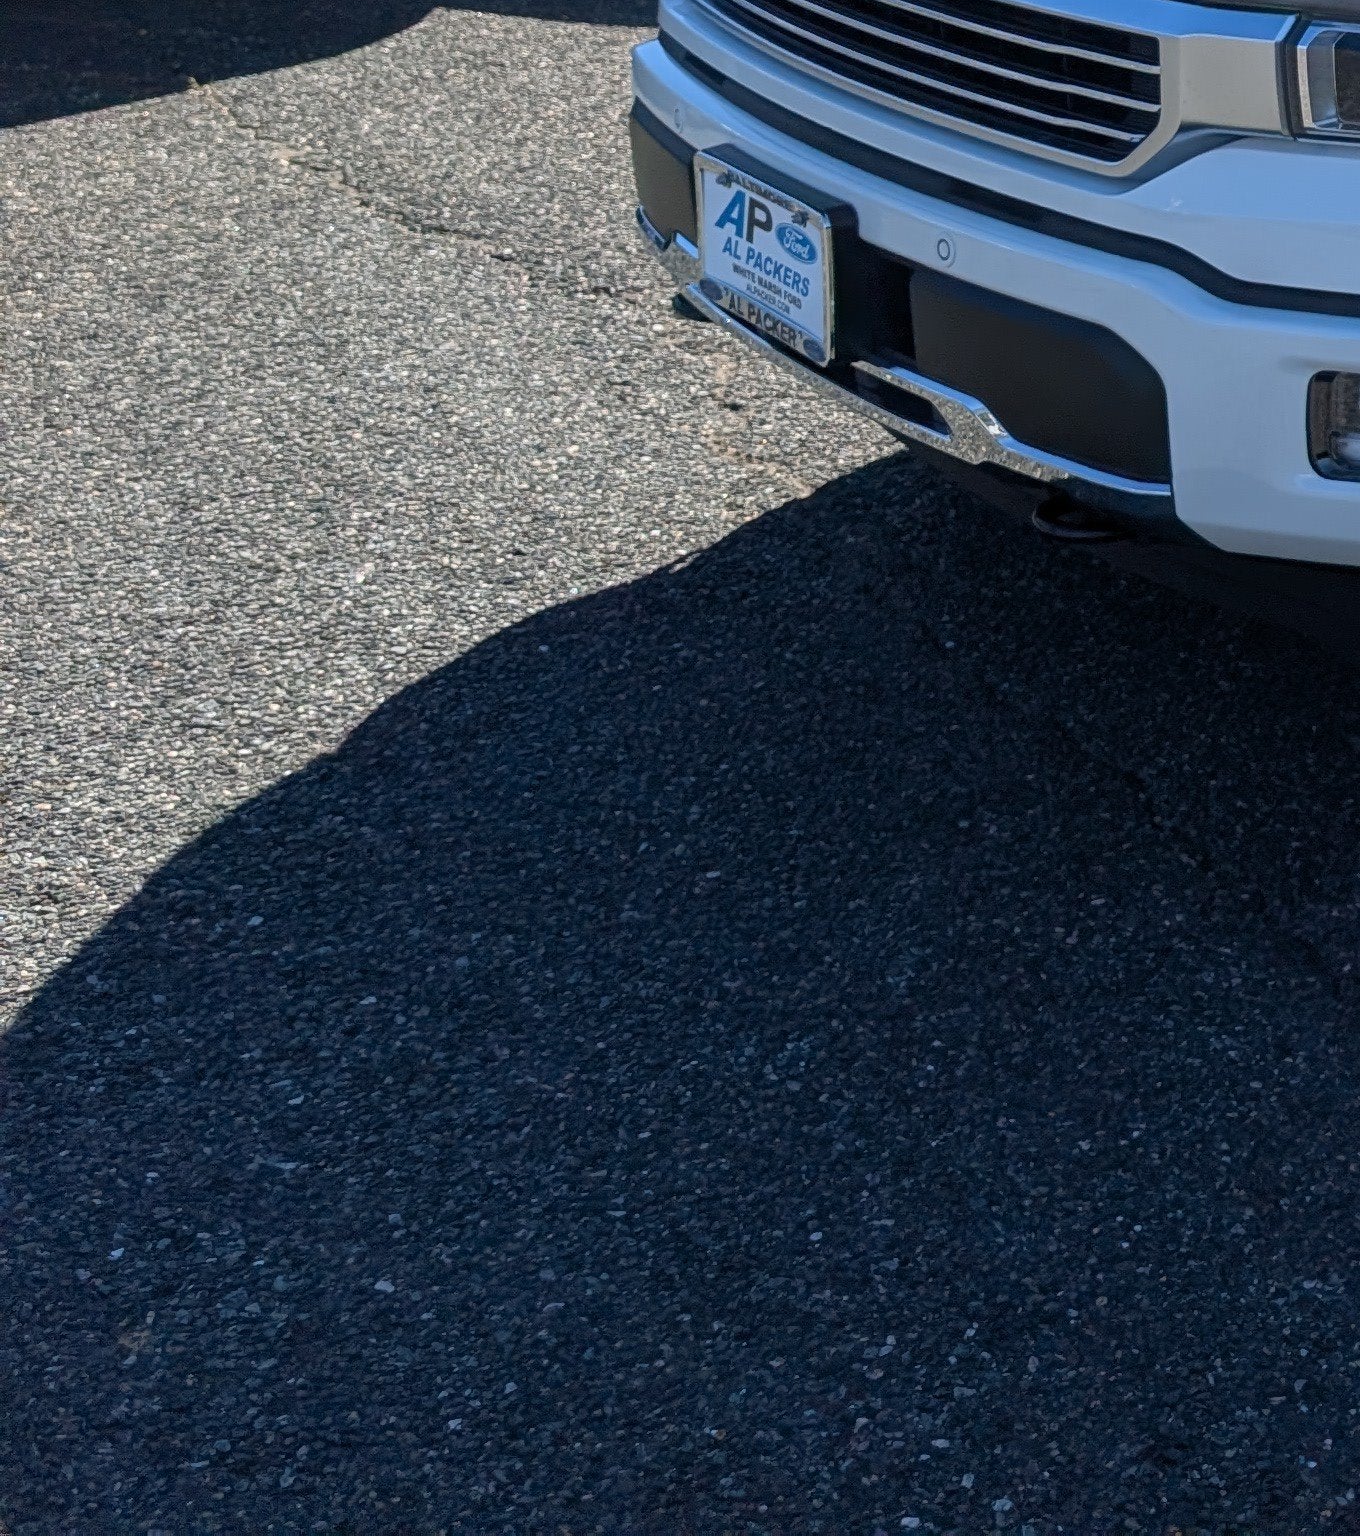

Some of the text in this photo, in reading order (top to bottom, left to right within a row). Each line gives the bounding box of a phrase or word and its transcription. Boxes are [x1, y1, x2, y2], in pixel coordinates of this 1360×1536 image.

[714, 189, 774, 245] AP
[783, 227, 812, 262] Ford
[722, 236, 810, 298] AL PACKERS
